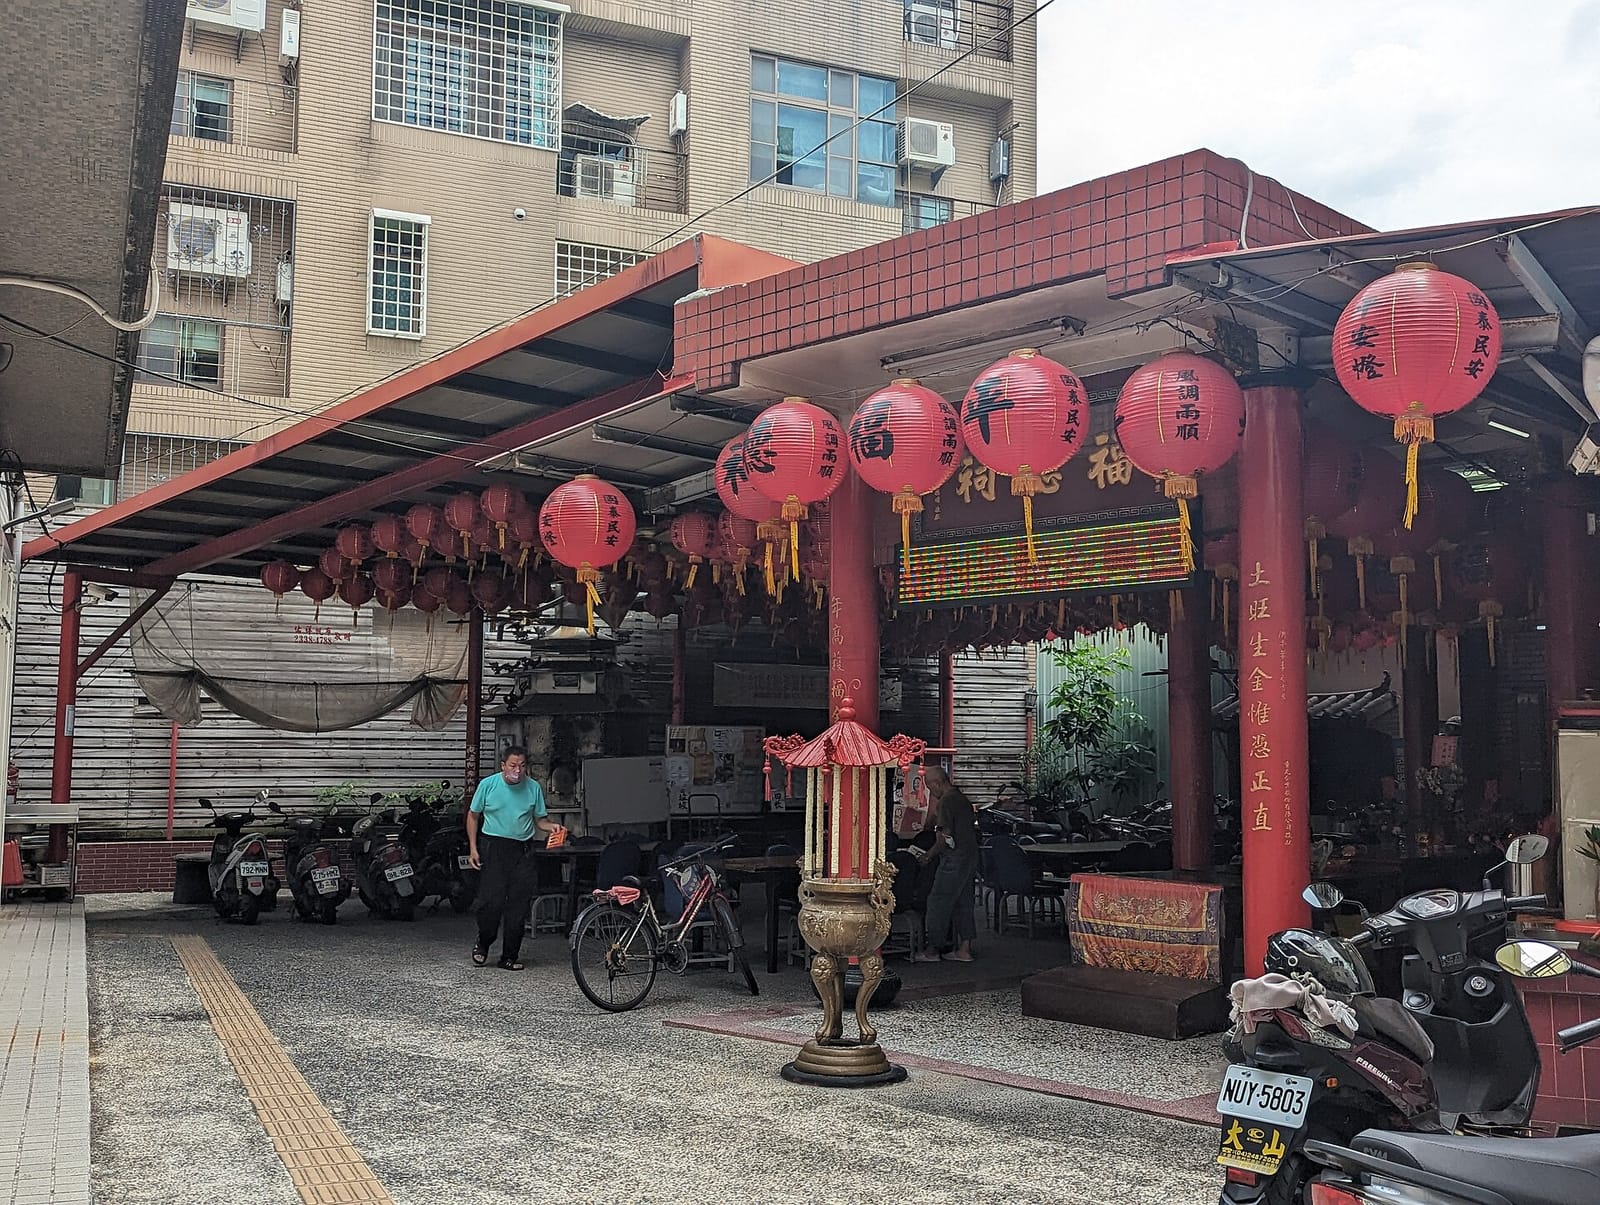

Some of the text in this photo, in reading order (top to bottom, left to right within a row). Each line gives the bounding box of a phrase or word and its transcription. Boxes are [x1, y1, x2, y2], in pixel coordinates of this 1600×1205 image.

[964, 375, 1016, 446] 平
[1059, 374, 1082, 444] 國泰民安
[1174, 368, 1200, 442] 風調雨順
[603, 494, 621, 548] 國泰民安
